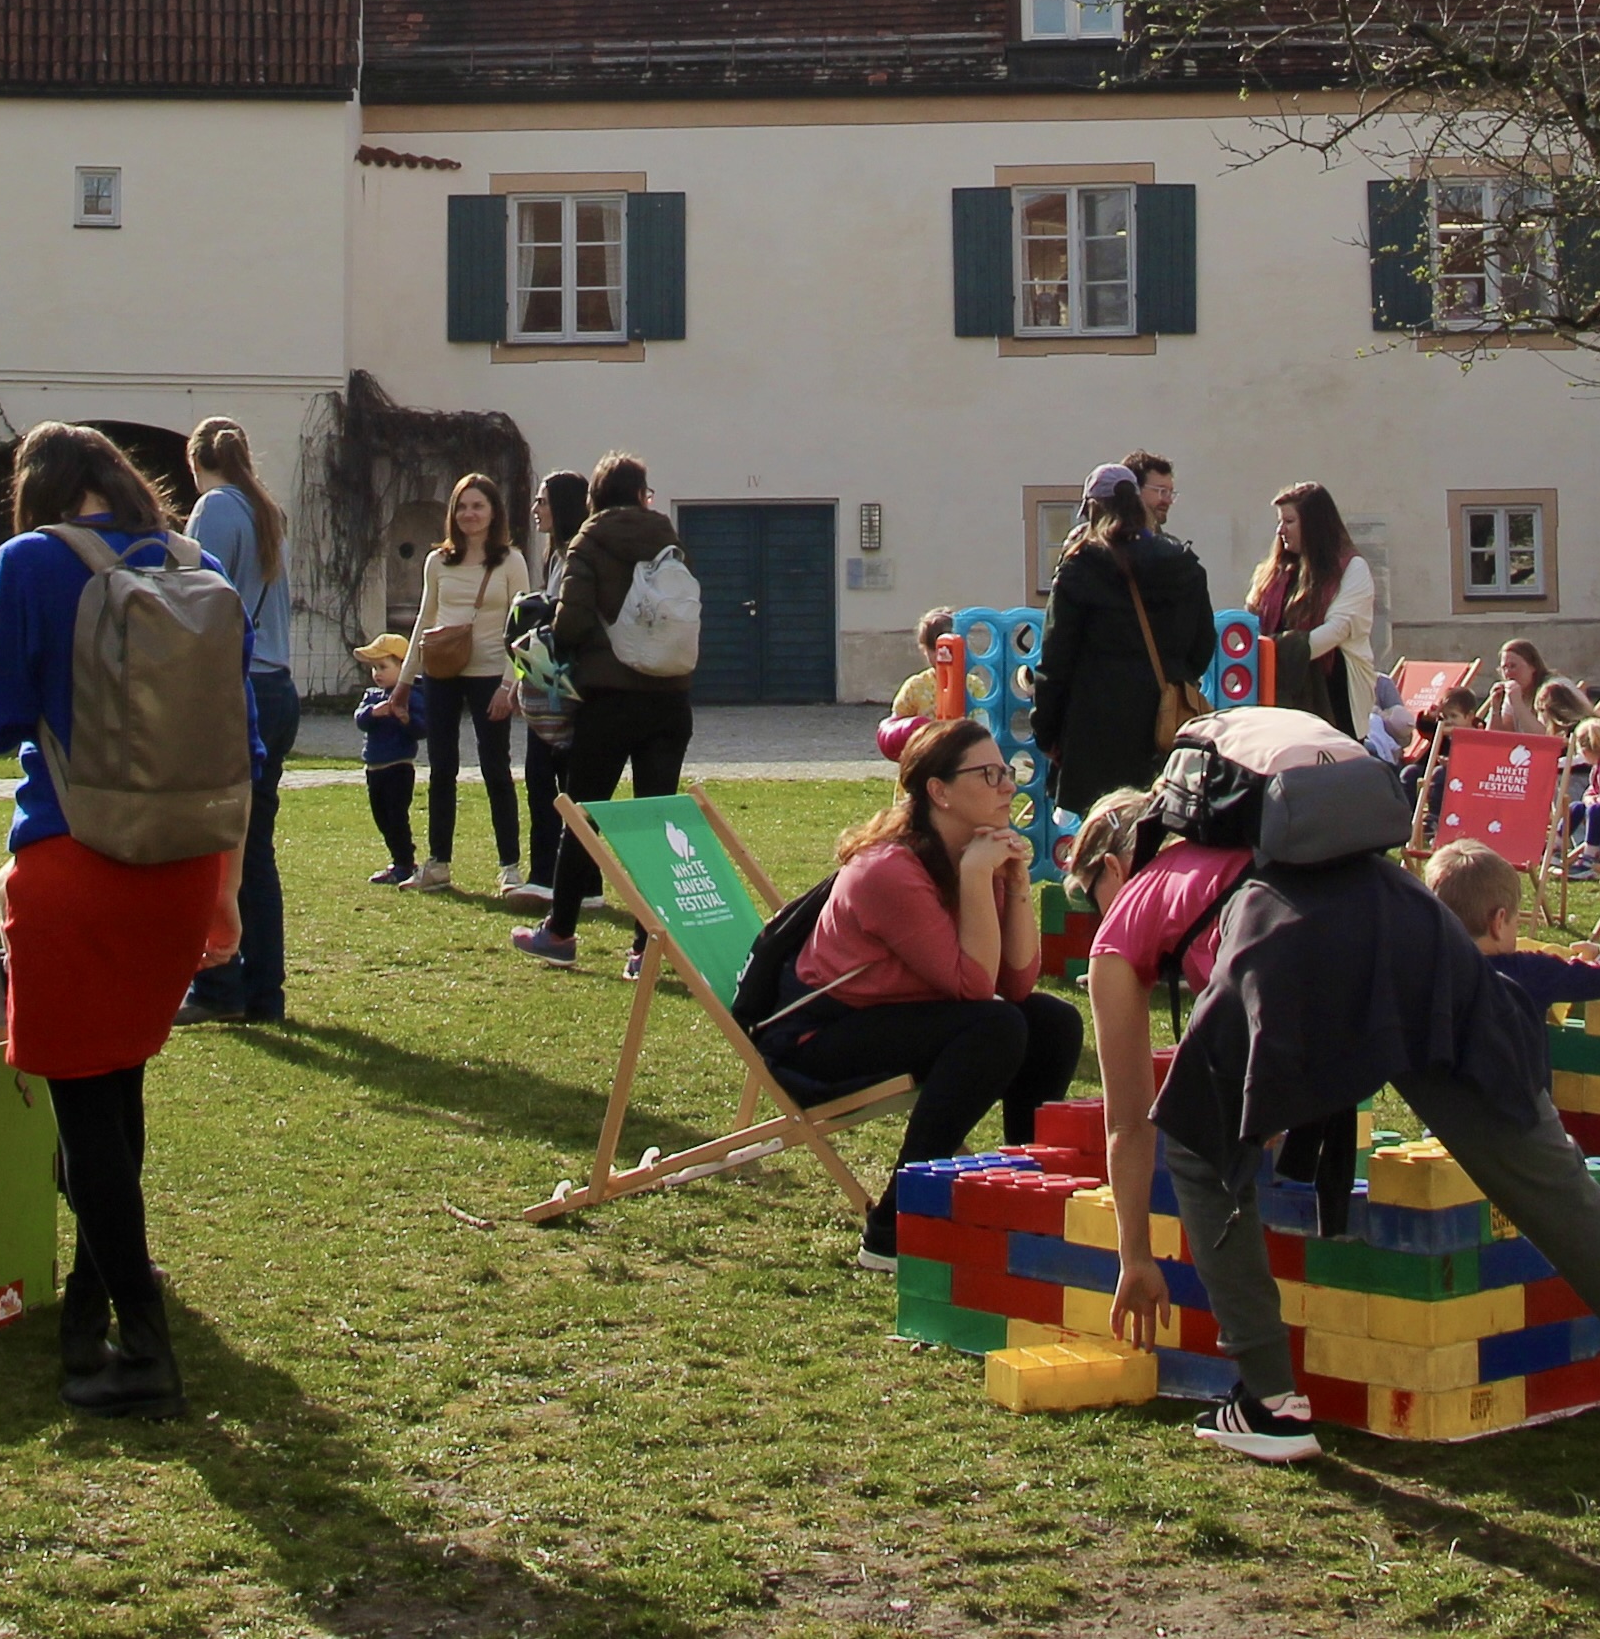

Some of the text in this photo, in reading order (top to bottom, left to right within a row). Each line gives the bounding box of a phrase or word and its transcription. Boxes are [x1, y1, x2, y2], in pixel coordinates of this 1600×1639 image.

[1488, 773, 1528, 785] RAVENS
[1478, 781, 1527, 794] FESTIVAL
[673, 875, 717, 895] RAVENS
[674, 891, 727, 912] FESTIVAL
